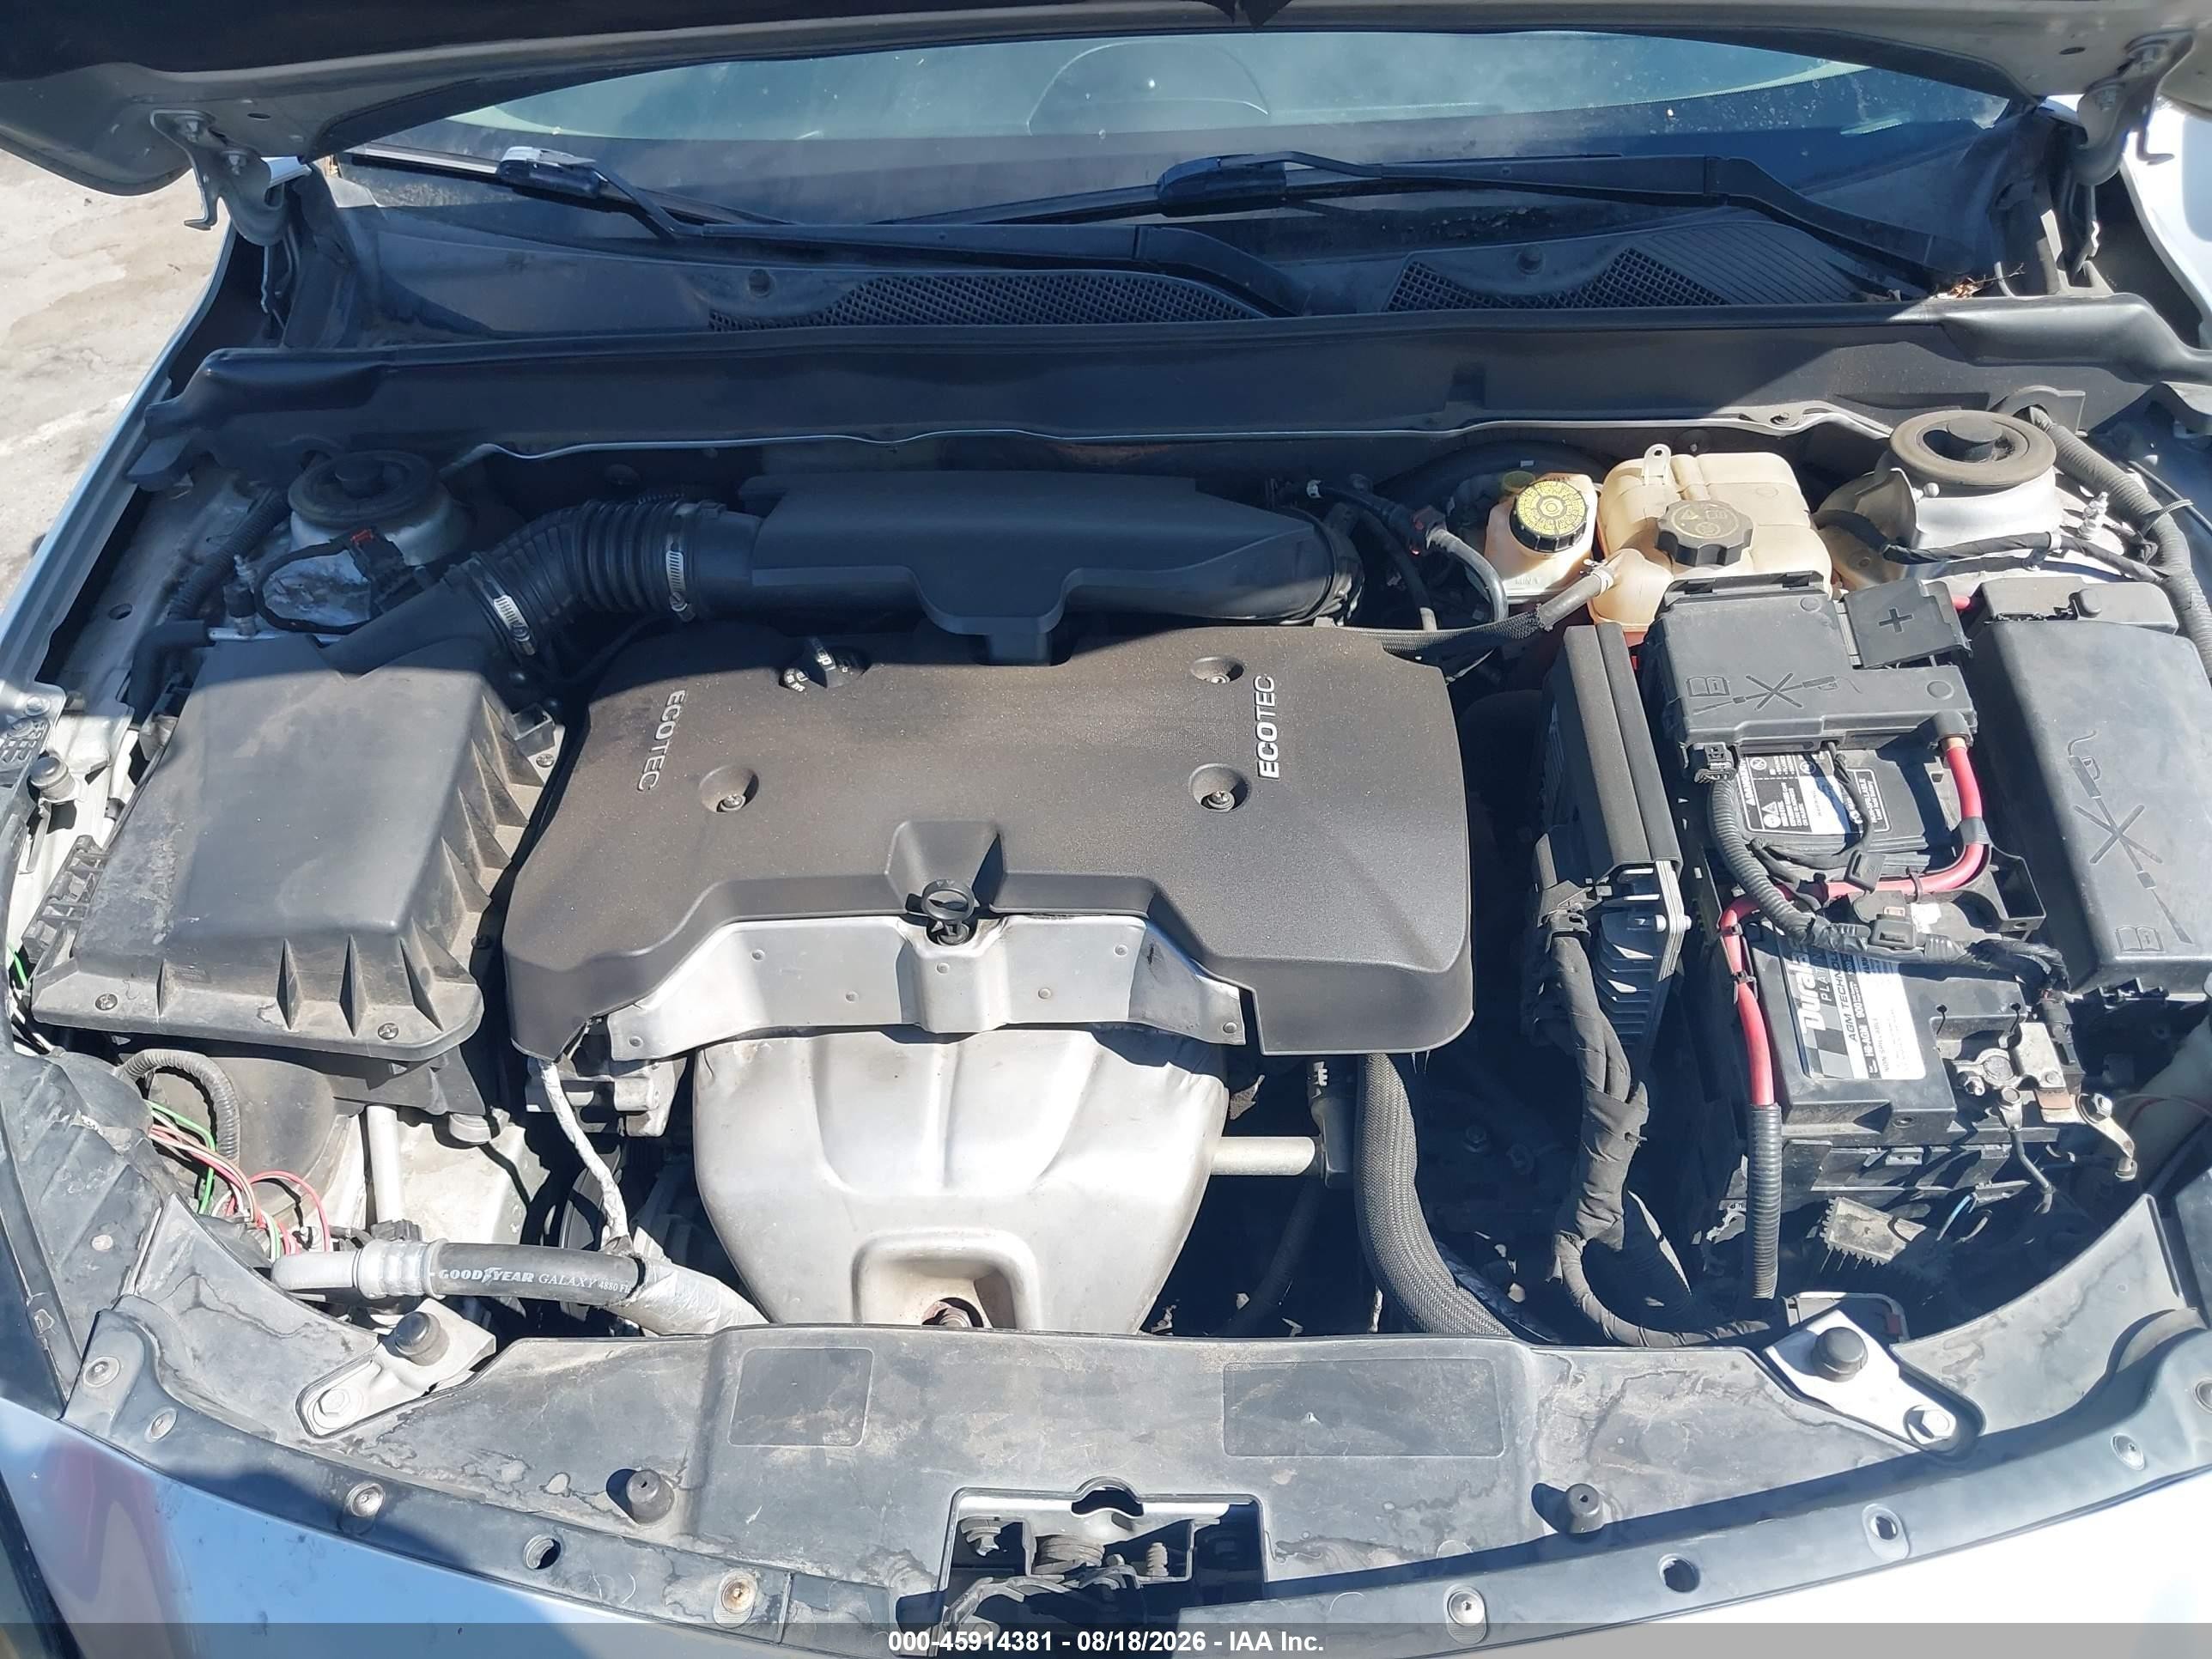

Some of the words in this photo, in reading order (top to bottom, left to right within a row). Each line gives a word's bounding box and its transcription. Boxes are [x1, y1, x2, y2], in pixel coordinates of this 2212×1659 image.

[637, 690, 686, 792] ECOTEC
[1254, 674, 1280, 780] ECOTEC
[1853, 1001, 1866, 1019] 900
[1844, 1013, 1859, 1042] AGM
[439, 1267, 535, 1285] GOODYEAR
[538, 1273, 598, 1289] GALAXY
